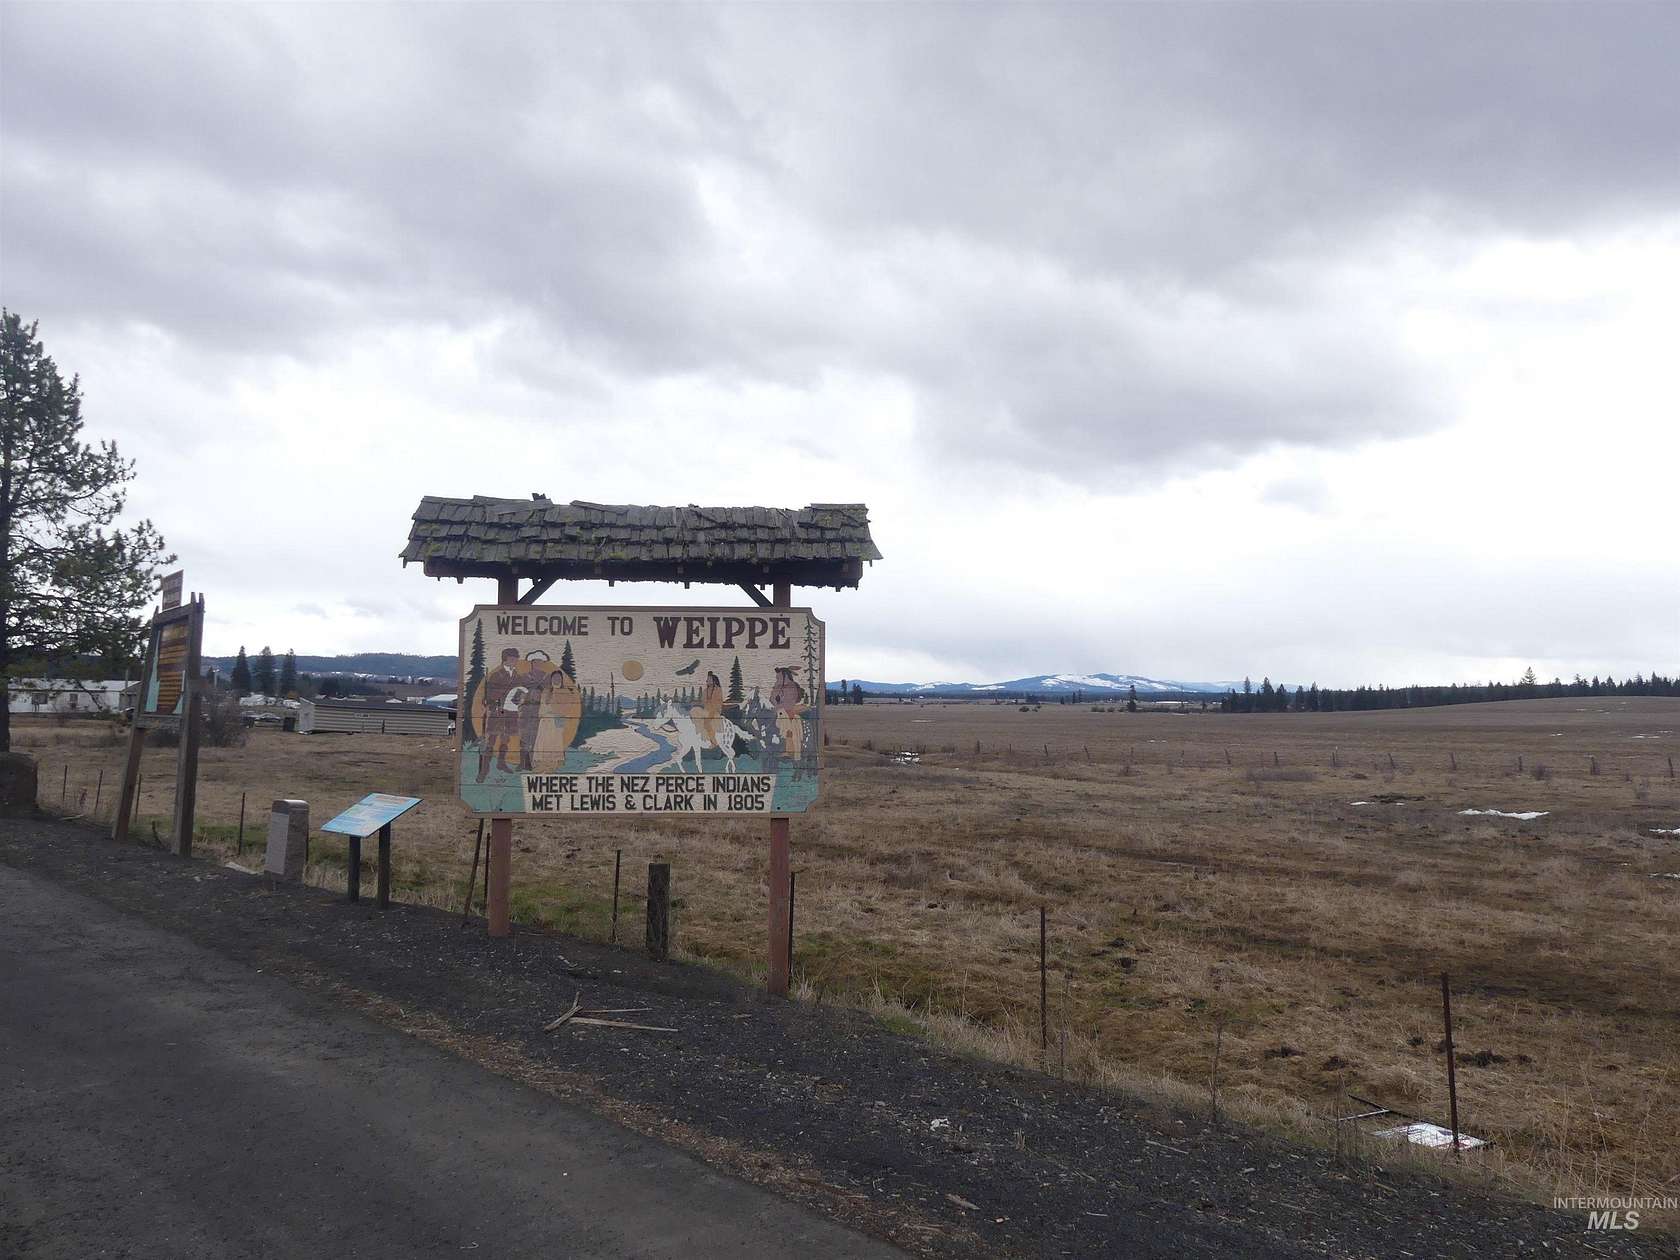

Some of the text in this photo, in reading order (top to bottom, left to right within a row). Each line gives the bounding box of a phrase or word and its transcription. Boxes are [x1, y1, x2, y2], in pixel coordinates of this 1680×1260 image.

[496, 615, 791, 649] WELCOME TO WEIPPE
[527, 776, 771, 793] WHERE THE NEZ PERCE INDIANS
[532, 794, 765, 811] MET LEWIS & CLARK IN 1805
